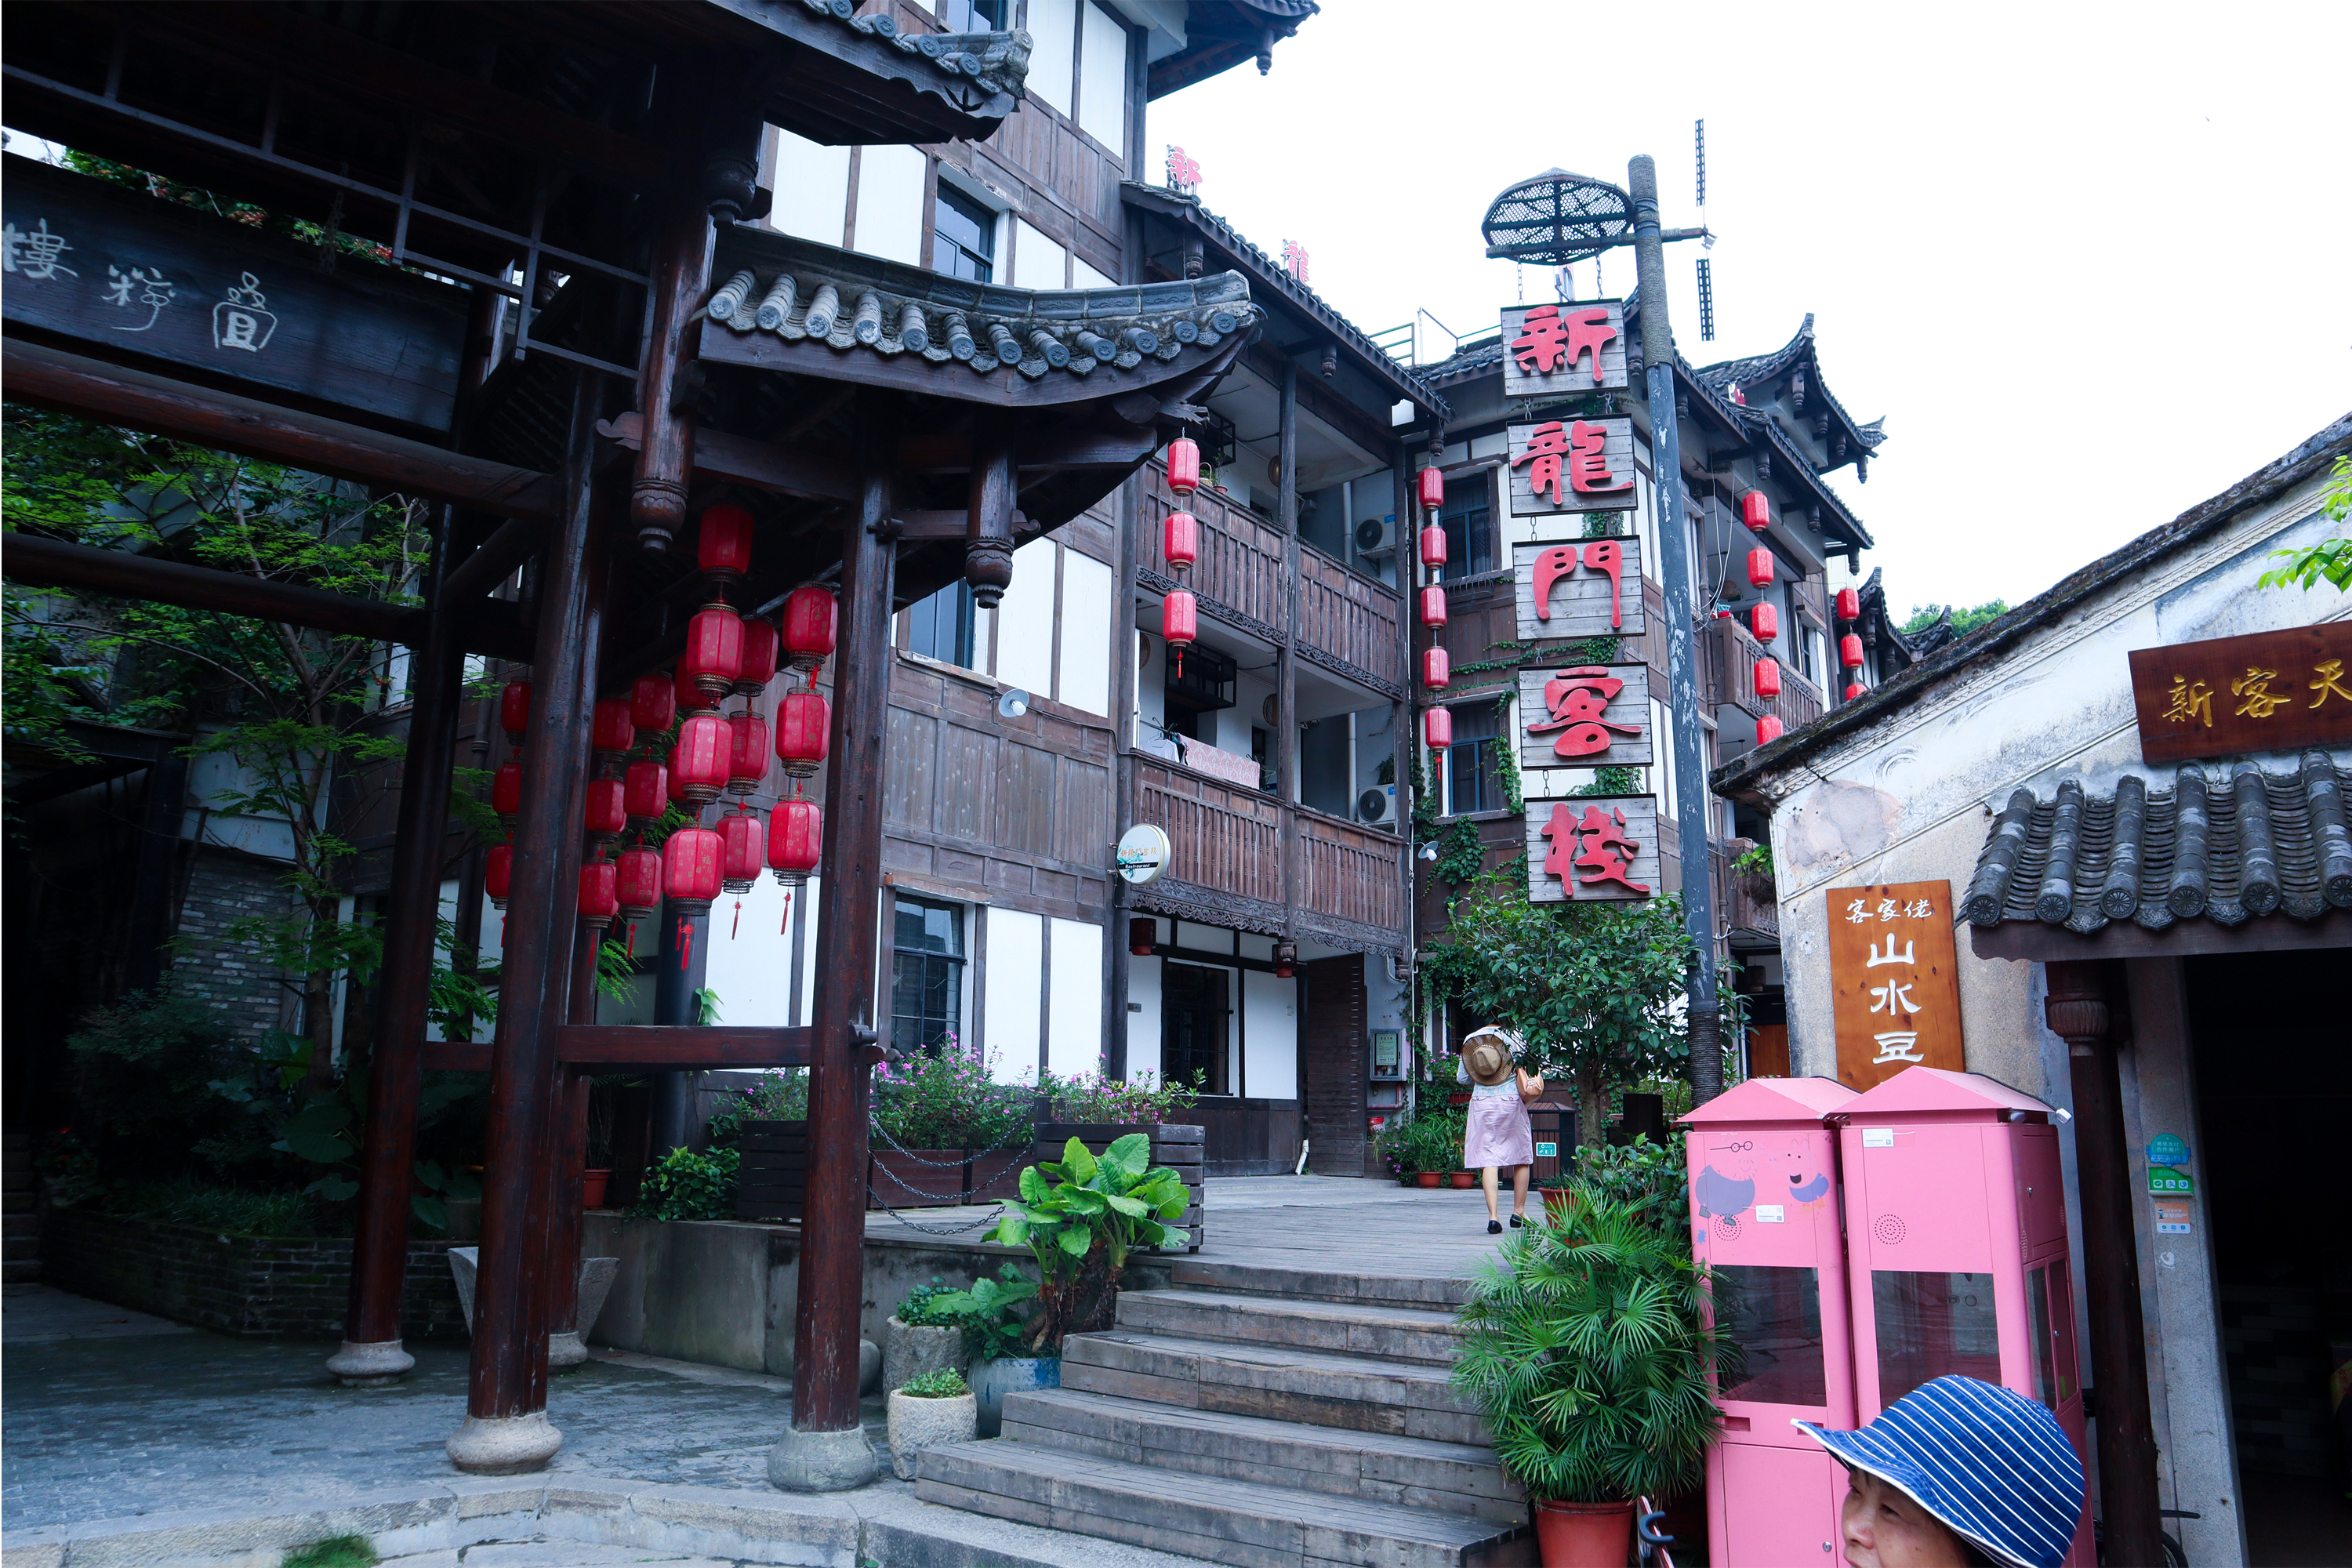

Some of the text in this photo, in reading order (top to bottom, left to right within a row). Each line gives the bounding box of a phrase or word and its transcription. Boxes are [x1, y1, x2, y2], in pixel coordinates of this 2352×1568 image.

[1845, 898, 1933, 924] 客家佬
[1866, 932, 1925, 1083] 山水豆
